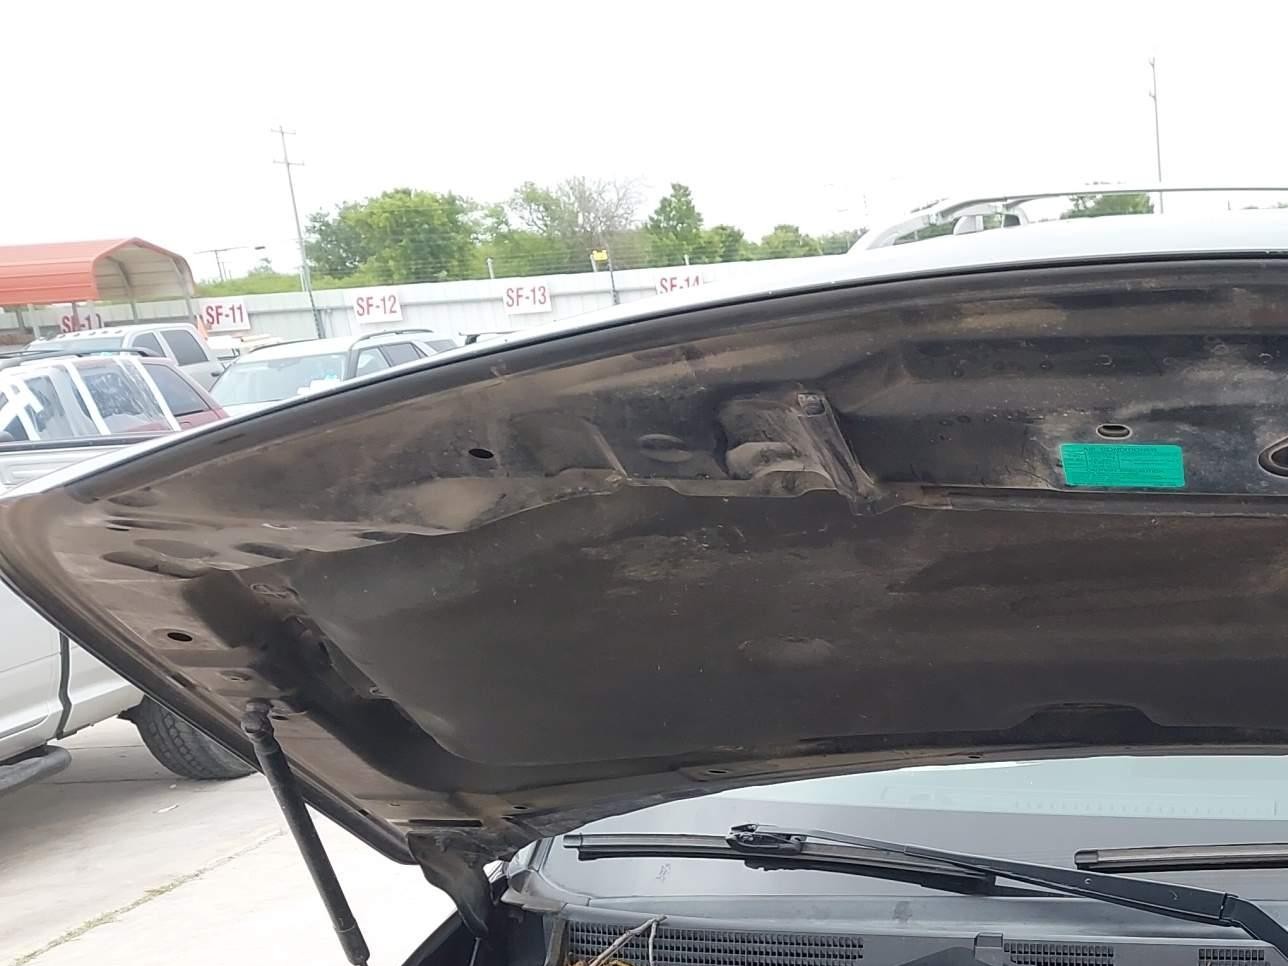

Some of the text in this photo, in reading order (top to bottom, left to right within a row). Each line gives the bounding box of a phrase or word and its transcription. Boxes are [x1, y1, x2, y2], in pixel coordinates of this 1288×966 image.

[356, 294, 397, 316] SF-12
[506, 285, 547, 307] SF-13
[206, 304, 244, 325] SF-11
